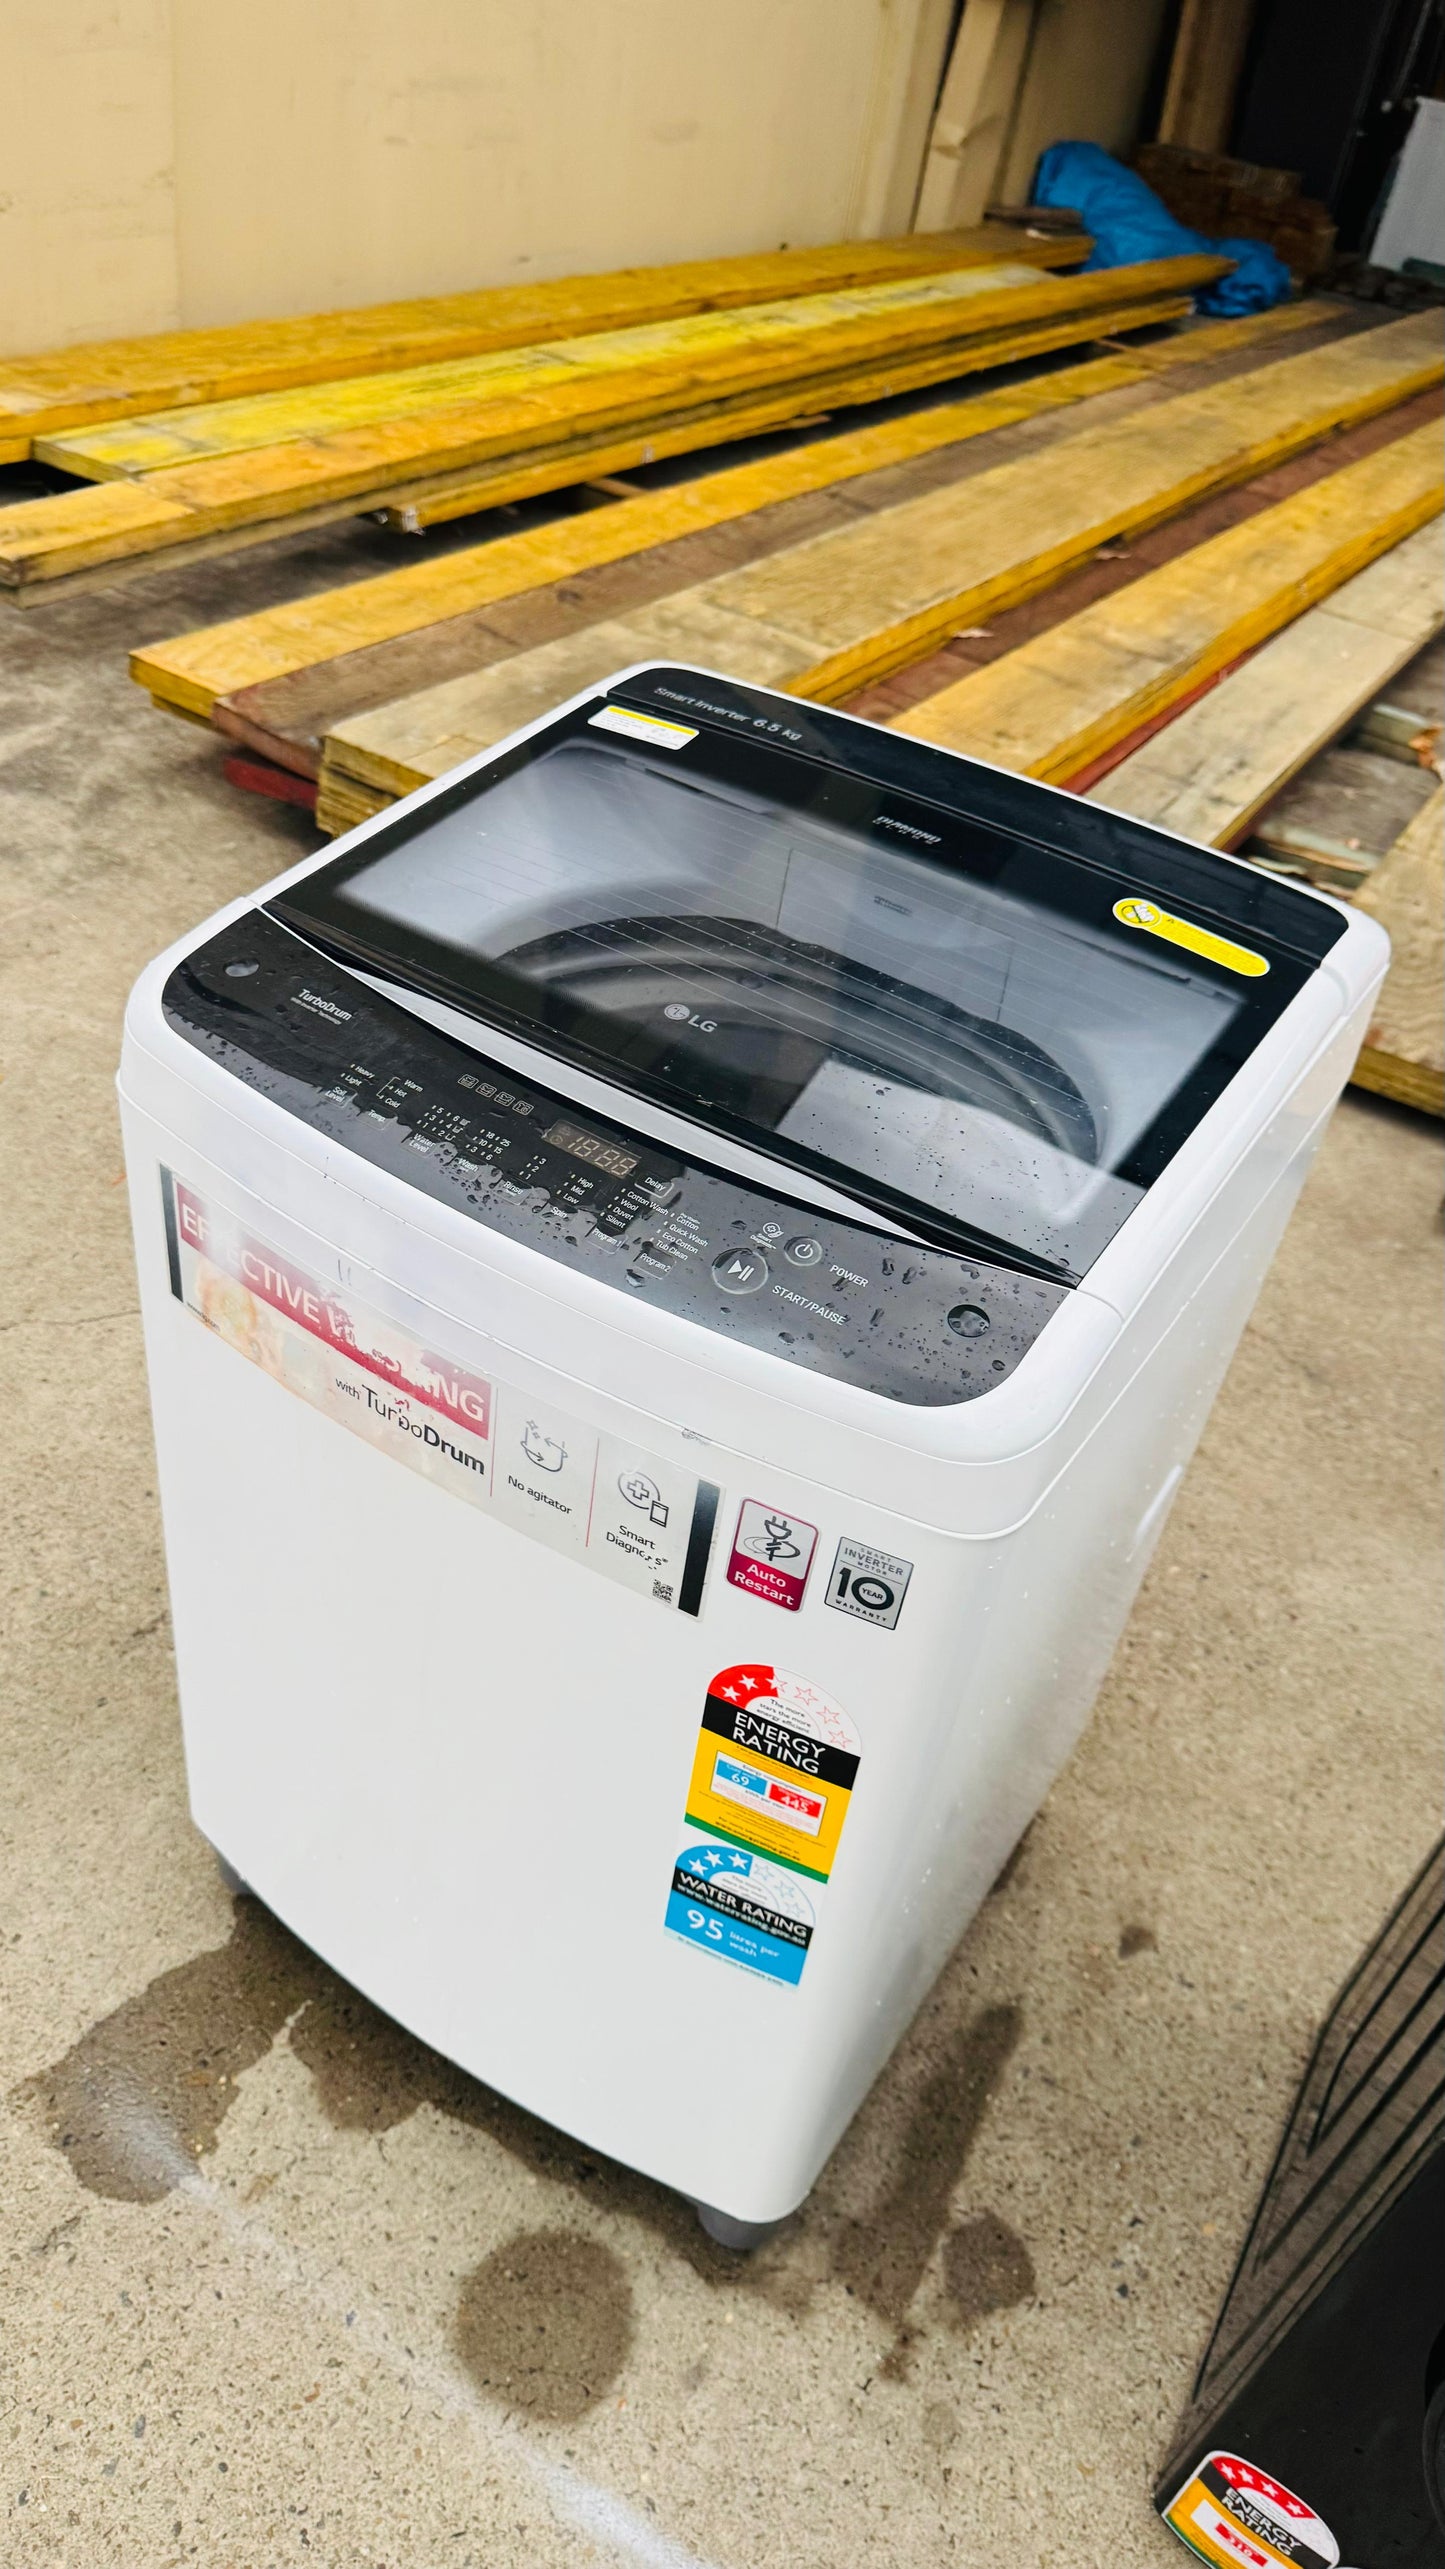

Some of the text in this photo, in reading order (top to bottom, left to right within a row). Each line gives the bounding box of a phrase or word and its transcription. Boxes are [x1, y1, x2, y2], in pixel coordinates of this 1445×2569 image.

[654, 687, 696, 705] Smart
[695, 699, 752, 722] Inverter
[781, 729, 803, 741] kg
[298, 988, 353, 1021] TurboDrum
[687, 1014, 718, 1032] LG
[355, 1065, 375, 1079] Heavy
[345, 1075, 362, 1086] Light
[404, 1079, 424, 1092] Warm
[325, 1090, 345, 1102] Level
[333, 1086, 348, 1096] Soil
[394, 1088, 408, 1098] Hot
[384, 1098, 401, 1108] Cold
[409, 1139, 429, 1153] Level
[413, 1133, 436, 1147] Water
[486, 1131, 511, 1147] 18 25
[493, 1146, 503, 1154] 15
[458, 1158, 479, 1172] Wash
[503, 1181, 523, 1195] Rinse
[570, 1185, 586, 1196] Mid
[577, 1177, 594, 1189] High
[644, 1177, 666, 1191] Delay
[563, 1193, 579, 1204] Low
[620, 1199, 639, 1212] Wool
[627, 1191, 669, 1216] Cotton Wash
[551, 1206, 568, 1219] Spin
[613, 1206, 634, 1220] Duvet
[606, 1214, 626, 1228] Silent
[677, 1216, 699, 1231] Cotton
[591, 1228, 618, 1244] Program
[662, 1232, 698, 1254] Eco Cotton
[669, 1223, 708, 1247] Quick Wash
[656, 1240, 688, 1261] Tub Clean
[640, 1252, 665, 1270] Program
[829, 1264, 869, 1288] POWER
[772, 1285, 847, 1326] START/PAUSE
[335, 1378, 485, 1475] with TurboDrum
[508, 1475, 573, 1515] No agitator
[619, 1525, 656, 1550] Smart
[843, 1547, 904, 1576] INVERTER
[861, 1547, 891, 1563] SMART
[746, 1563, 786, 1588] Auto
[857, 1562, 887, 1576] MOTOR
[734, 1571, 794, 1606] Restart
[837, 1567, 895, 1611] 10
[862, 1587, 884, 1600] YEAR
[835, 1599, 888, 1622] WARRANTY
[760, 1703, 811, 1727] stars the more
[770, 1698, 805, 1718] The more
[734, 1711, 826, 1759] ENERGY
[732, 1727, 820, 1774] RATING
[731, 1773, 750, 1786] 69
[680, 1871, 737, 1908] WATER
[741, 1901, 808, 1938] RATING
[687, 1908, 780, 1957] 95 litres per
[729, 1941, 757, 1957] wash
[1225, 2487, 1302, 2548] ENERGY
[1222, 2496, 1293, 2556] RATING
